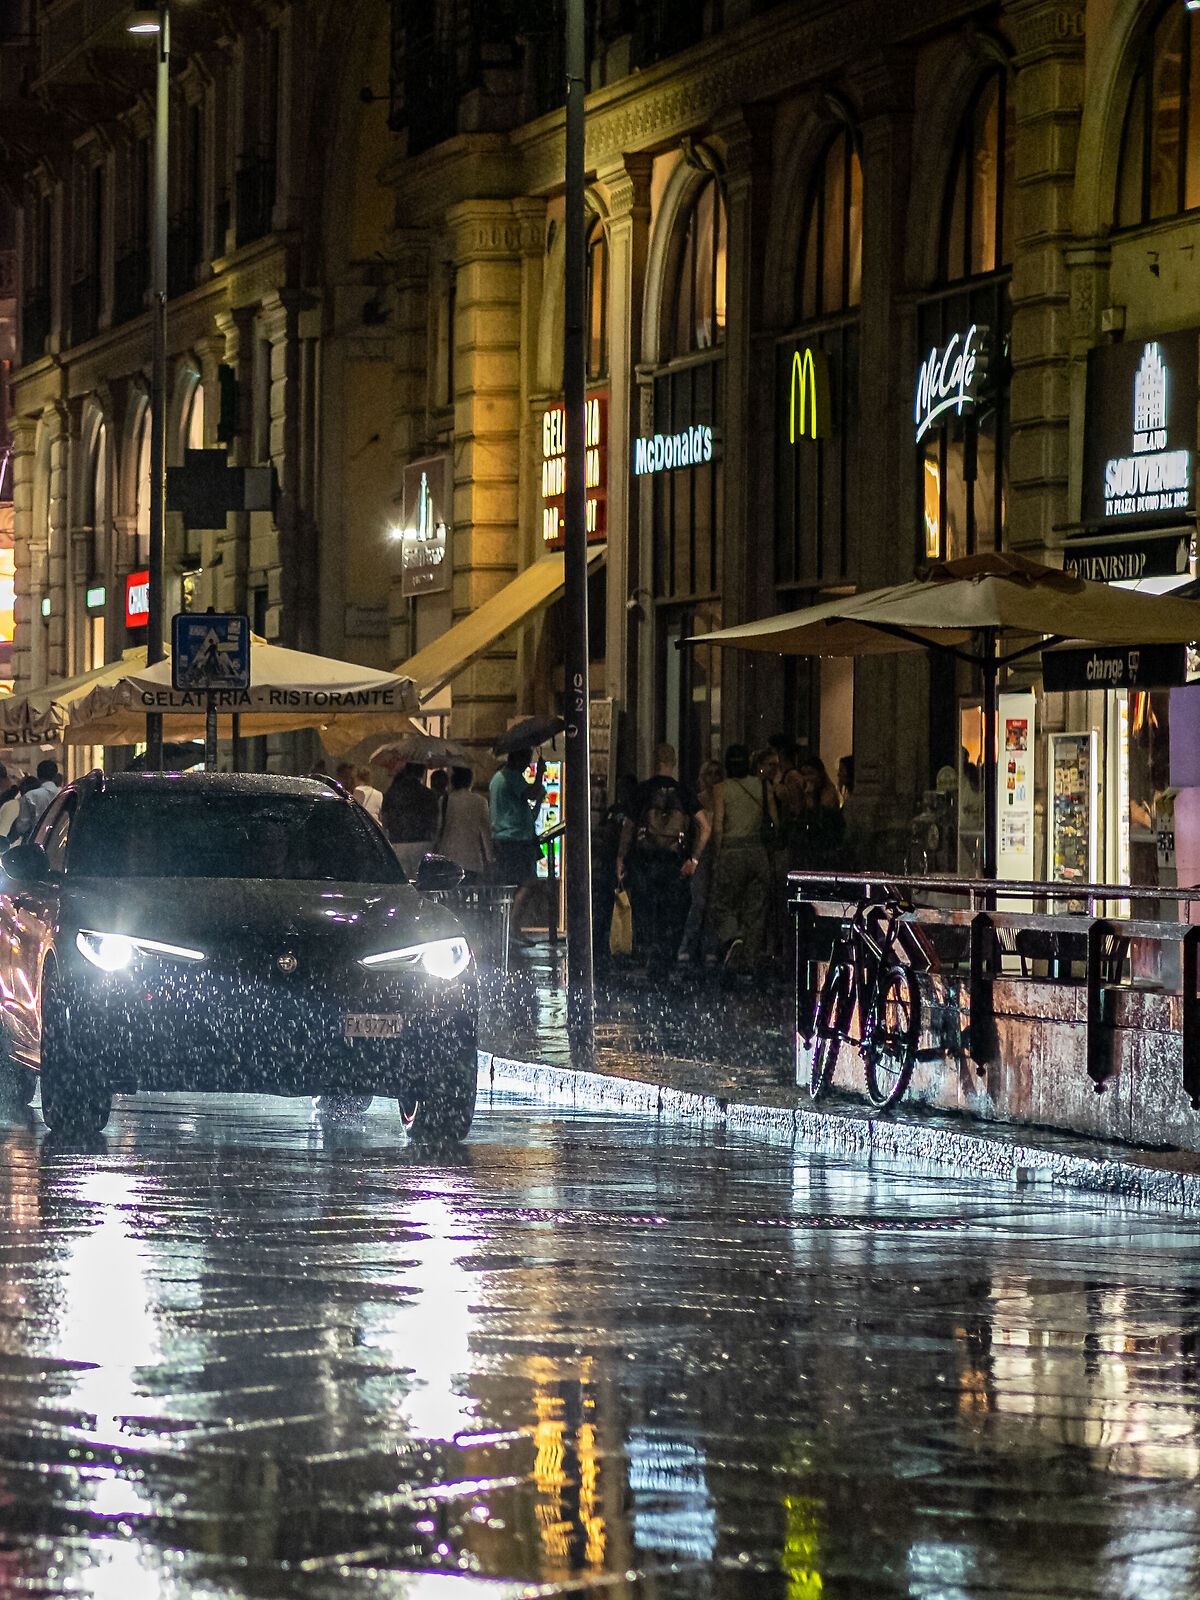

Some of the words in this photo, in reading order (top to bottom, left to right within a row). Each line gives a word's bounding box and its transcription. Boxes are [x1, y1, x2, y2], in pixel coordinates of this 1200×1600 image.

[915, 324, 977, 426] McCafé
[635, 424, 712, 475] McDonald's
[141, 689, 252, 706] GELATRIA
[269, 689, 395, 706] RISTORANTE
